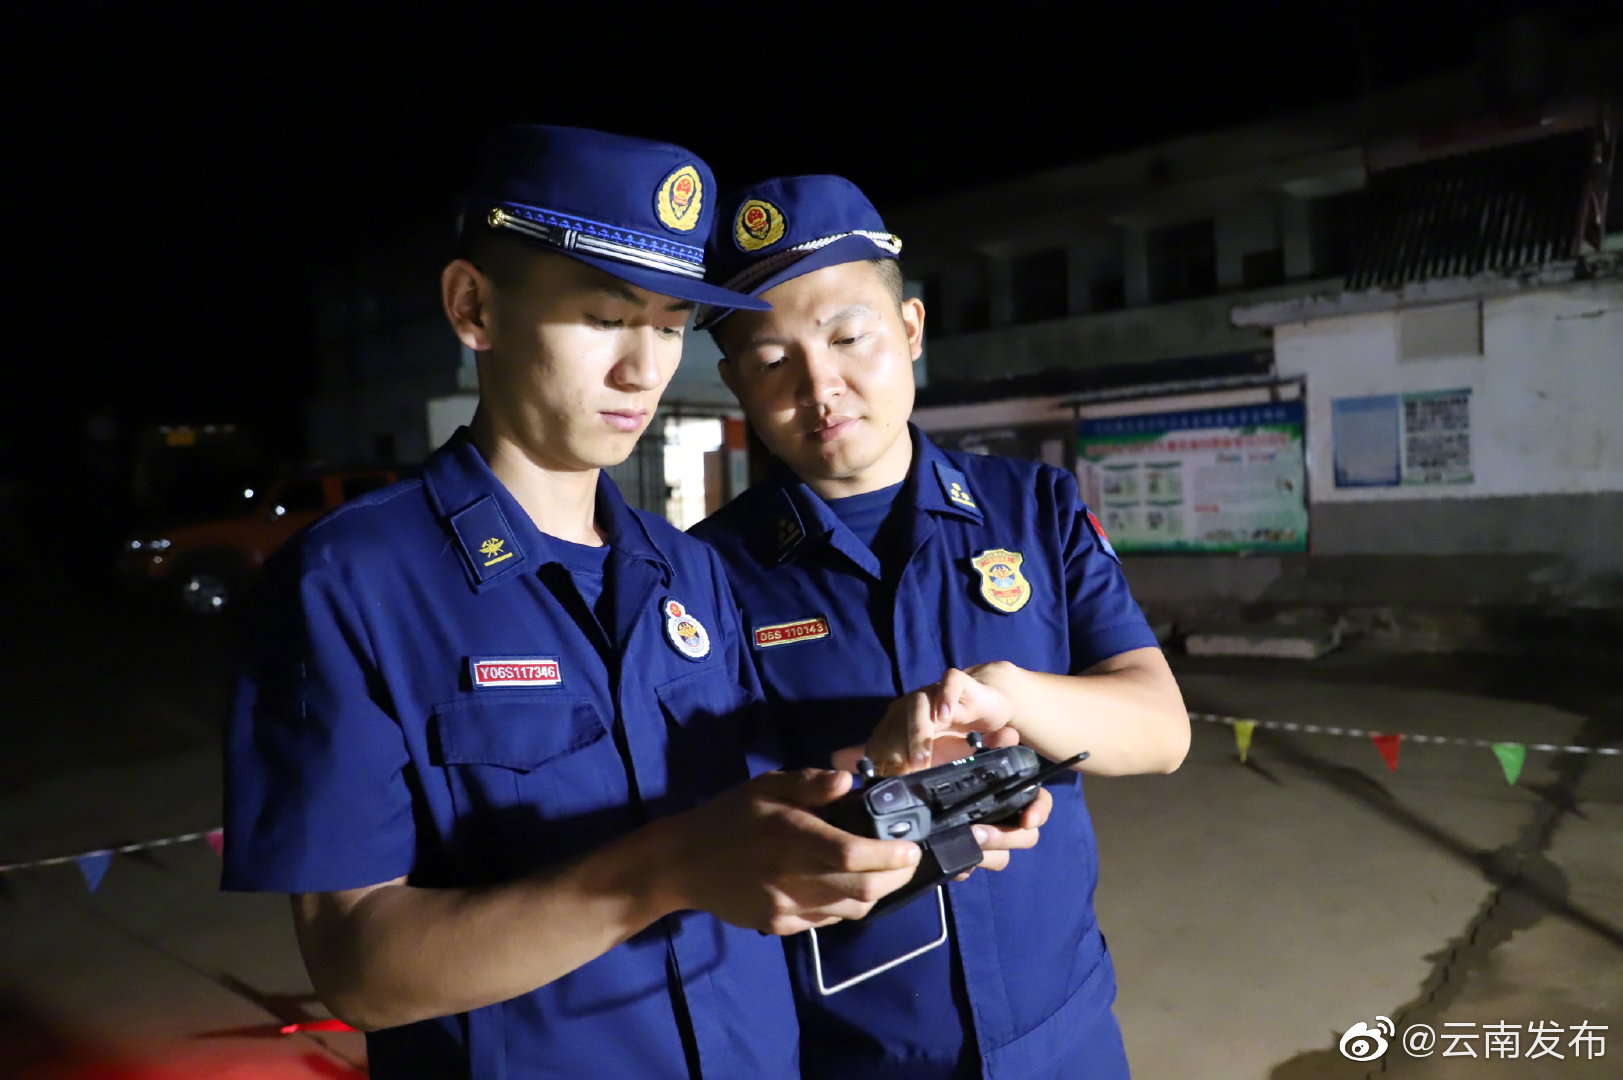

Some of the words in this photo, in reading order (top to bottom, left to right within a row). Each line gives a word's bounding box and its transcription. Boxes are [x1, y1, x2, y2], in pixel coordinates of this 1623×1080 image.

[760, 630, 782, 642] 06S
[785, 622, 824, 638] 110143
[480, 666, 556, 679] Y06S117346
